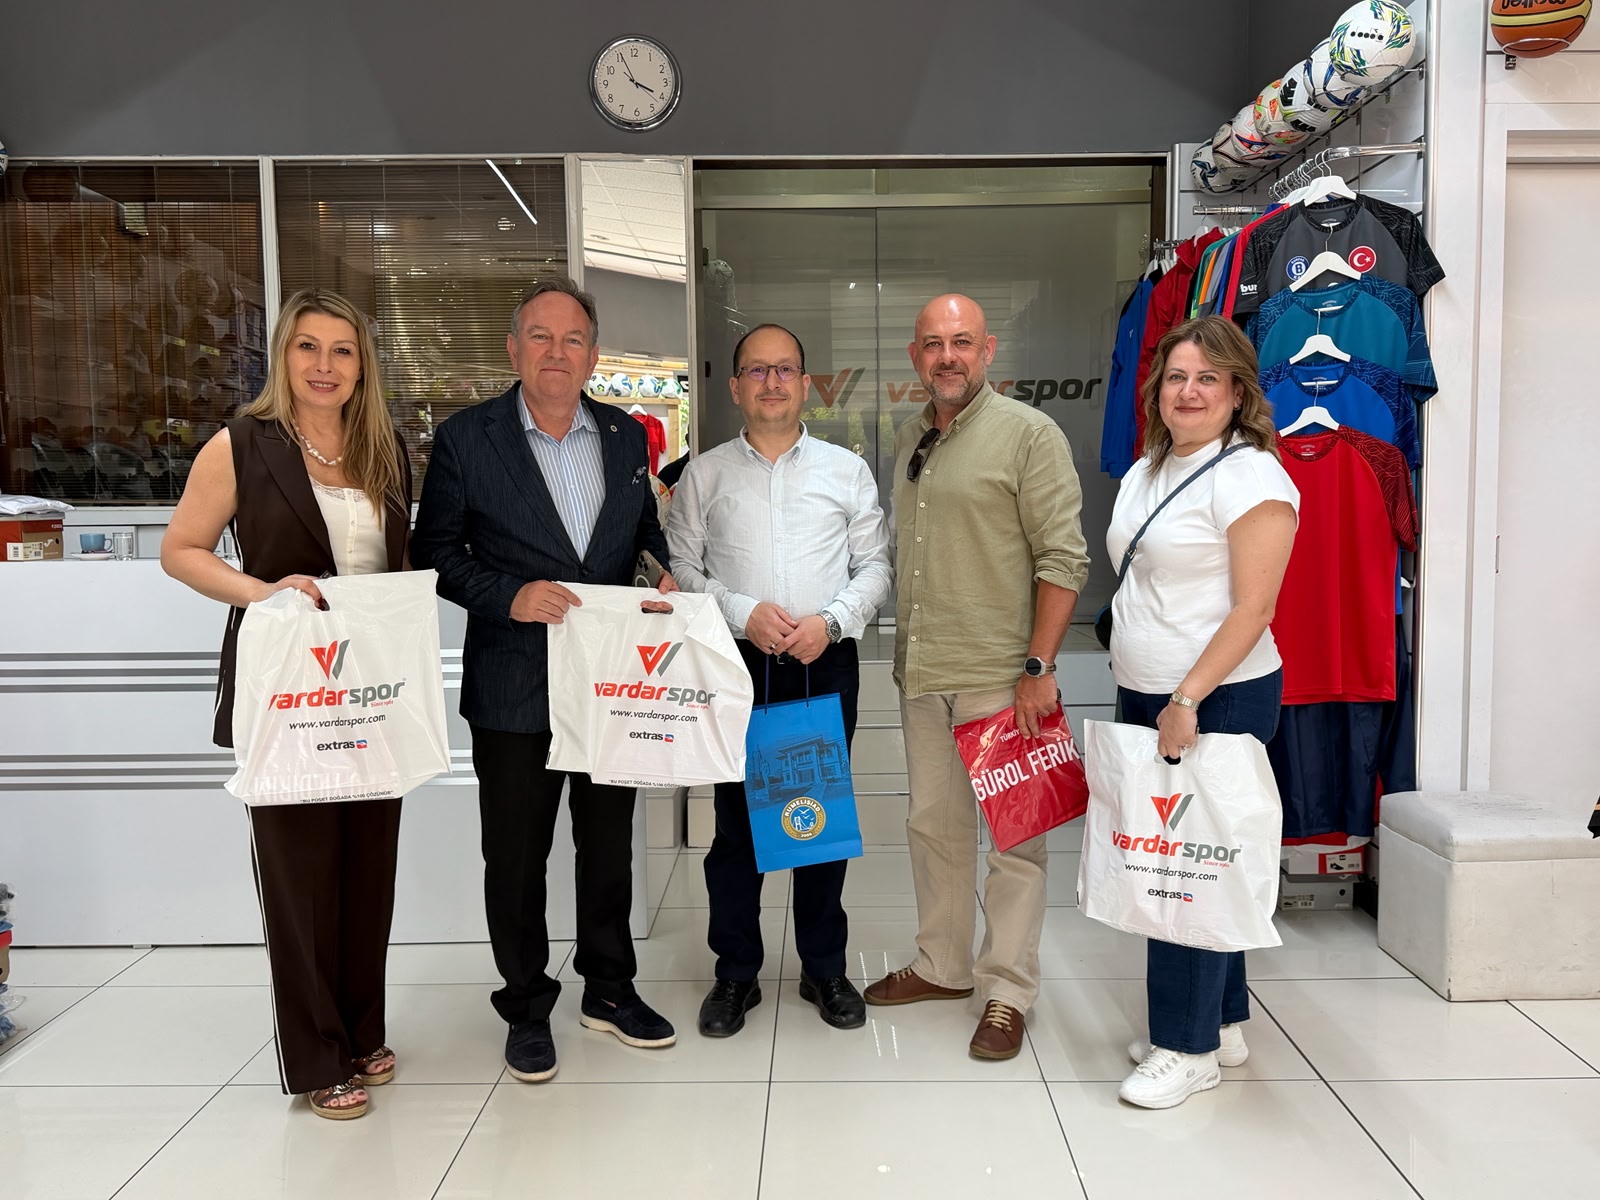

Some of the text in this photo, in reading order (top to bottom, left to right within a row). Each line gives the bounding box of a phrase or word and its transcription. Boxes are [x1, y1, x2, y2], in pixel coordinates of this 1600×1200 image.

[630, 48, 639, 58] 12
[606, 65, 615, 75] 10
[659, 64, 665, 74] 2
[602, 79, 609, 89] 9
[662, 78, 669, 87] 3
[607, 93, 614, 103] 8
[659, 92, 664, 100] 4
[618, 104, 624, 114] 7
[633, 107, 640, 117] 6
[649, 103, 655, 113] 5
[1295, 263, 1303, 274] B
[885, 378, 1103, 407] varspor
[594, 681, 716, 706] vardarspor
[289, 713, 386, 729] www.vardarspor.com
[610, 709, 698, 723] www.vardarspor.com
[629, 731, 663, 741] extras
[1000, 729, 1020, 743] TÜRKİY
[317, 740, 355, 751] extras
[971, 737, 1081, 802] GÜROL FERİK
[1112, 830, 1242, 864] vardarspor
[1124, 863, 1218, 882] www.vardarspor.com
[1147, 888, 1182, 900] extras
